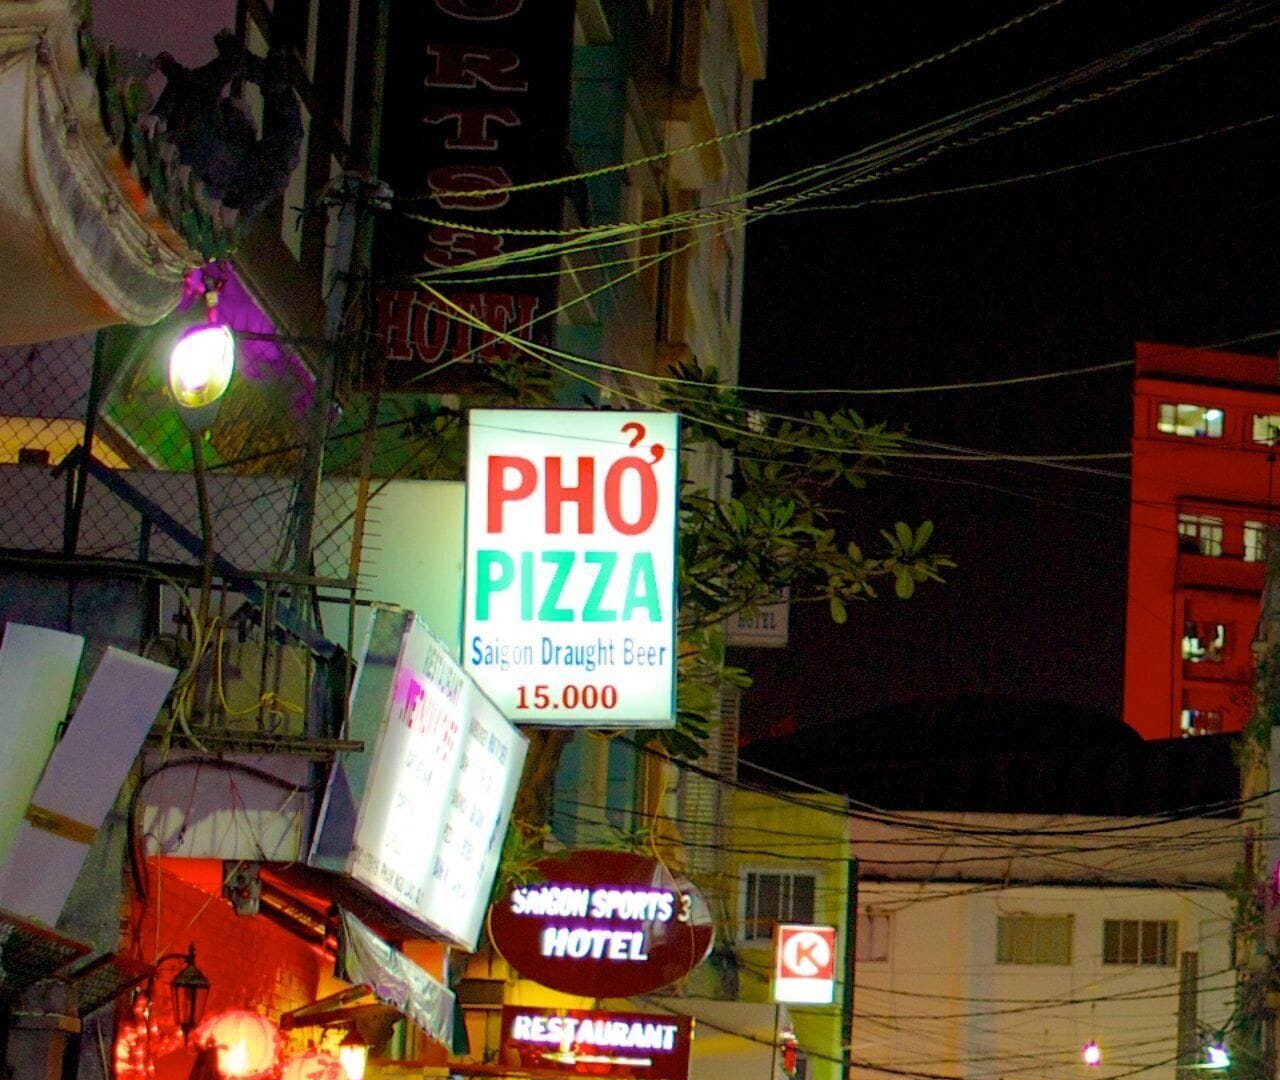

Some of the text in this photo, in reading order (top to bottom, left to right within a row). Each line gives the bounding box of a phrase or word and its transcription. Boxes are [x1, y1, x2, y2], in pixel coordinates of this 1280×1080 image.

[474, 549, 663, 623] PIZZA
[471, 636, 668, 672] Saigon Draught Beer
[515, 684, 619, 710] 15.000
[511, 886, 692, 923] SAIGON SPORTS 3
[541, 927, 650, 961] HOTEL
[512, 1014, 678, 1051] RESTAURANT
